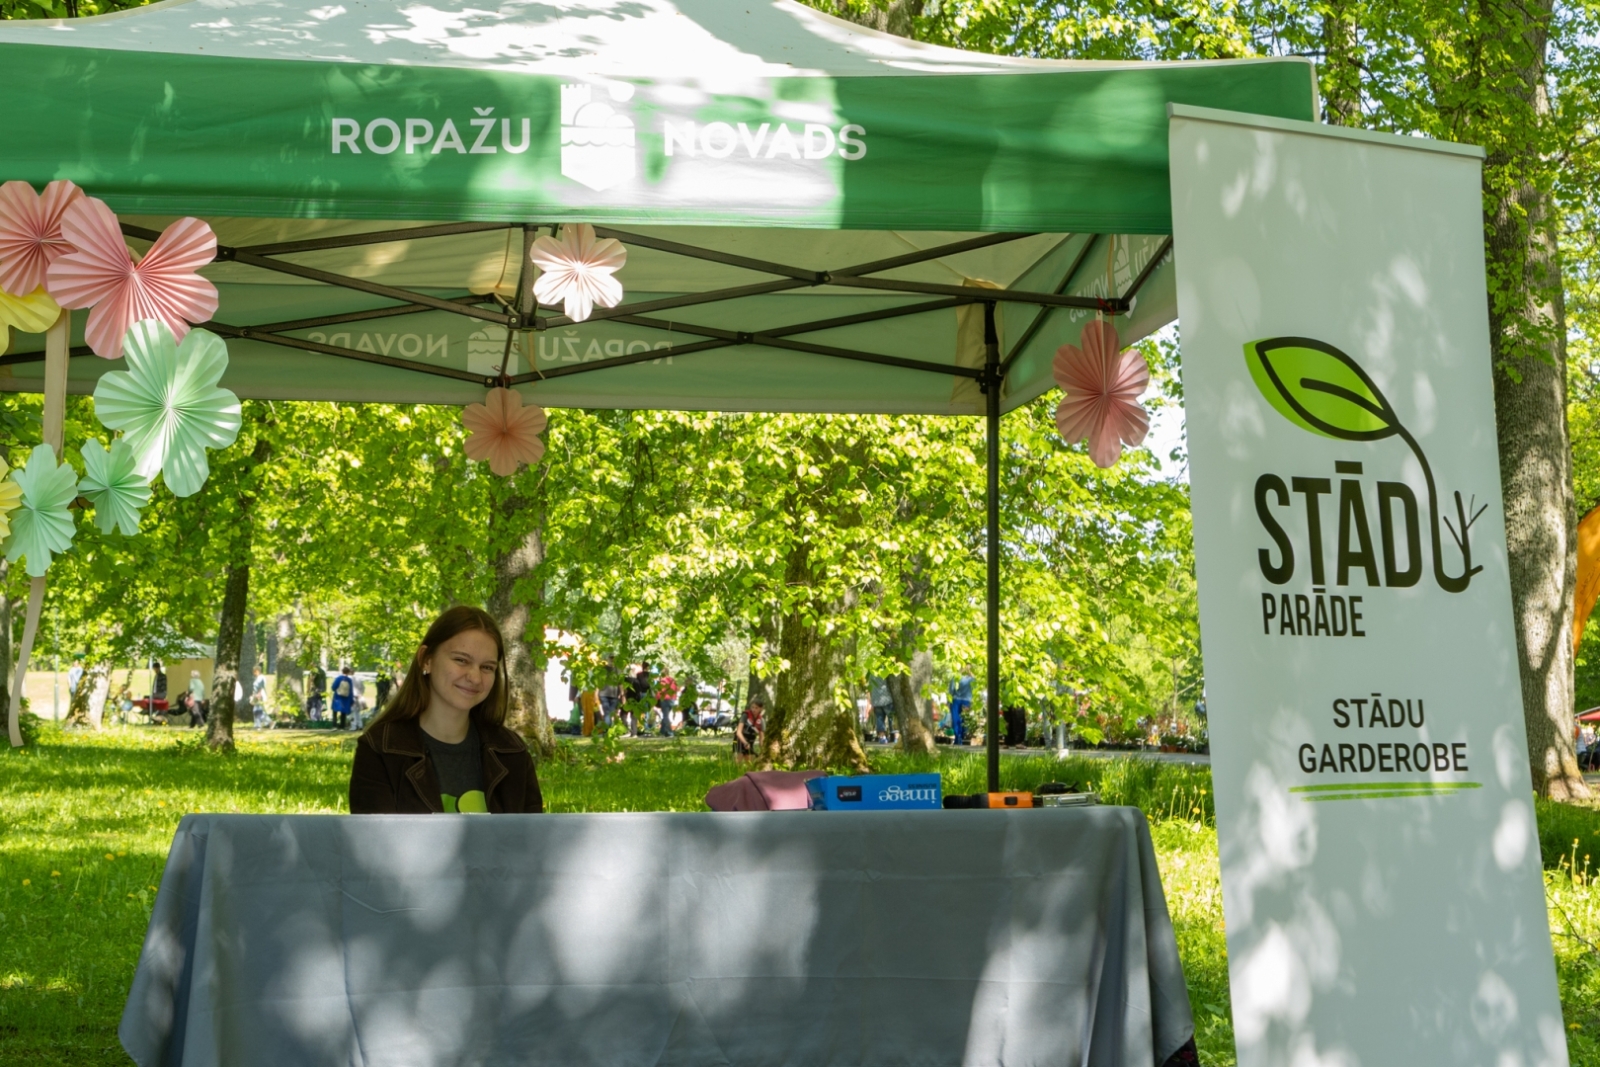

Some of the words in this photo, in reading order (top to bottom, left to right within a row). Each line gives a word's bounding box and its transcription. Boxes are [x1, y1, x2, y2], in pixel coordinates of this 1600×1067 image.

[332, 107, 530, 154] ROPAŽU
[664, 120, 867, 160] NOVADS
[1254, 460, 1487, 593] STĀDU
[1261, 588, 1366, 637] PARĀDE
[1332, 693, 1425, 728] STĀDU
[1298, 742, 1469, 774] GARDEROBE
[879, 785, 937, 804] image
